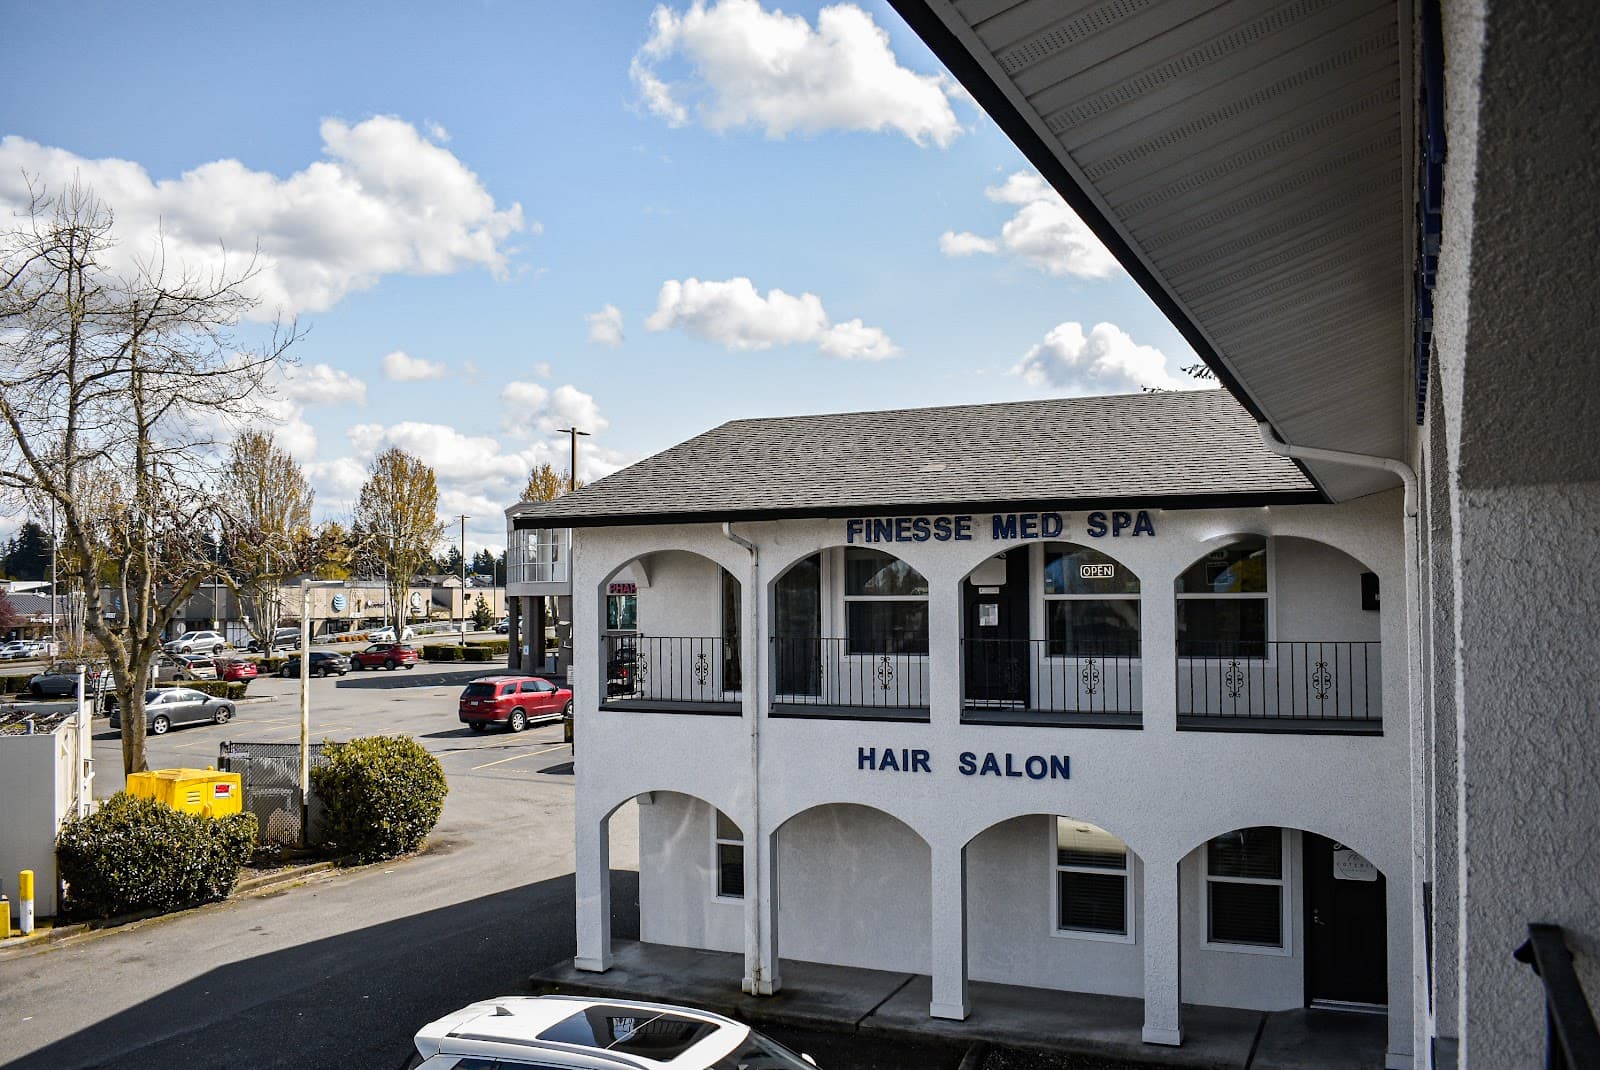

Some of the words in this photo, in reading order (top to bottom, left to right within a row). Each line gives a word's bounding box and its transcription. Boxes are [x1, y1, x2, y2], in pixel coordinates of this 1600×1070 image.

[847, 516, 972, 543] FINESSE
[992, 512, 1063, 540] MED
[1087, 510, 1155, 537] SPA
[1083, 566, 1112, 576] OPEN
[857, 747, 932, 773] HAIR
[958, 751, 1071, 780] SALON
